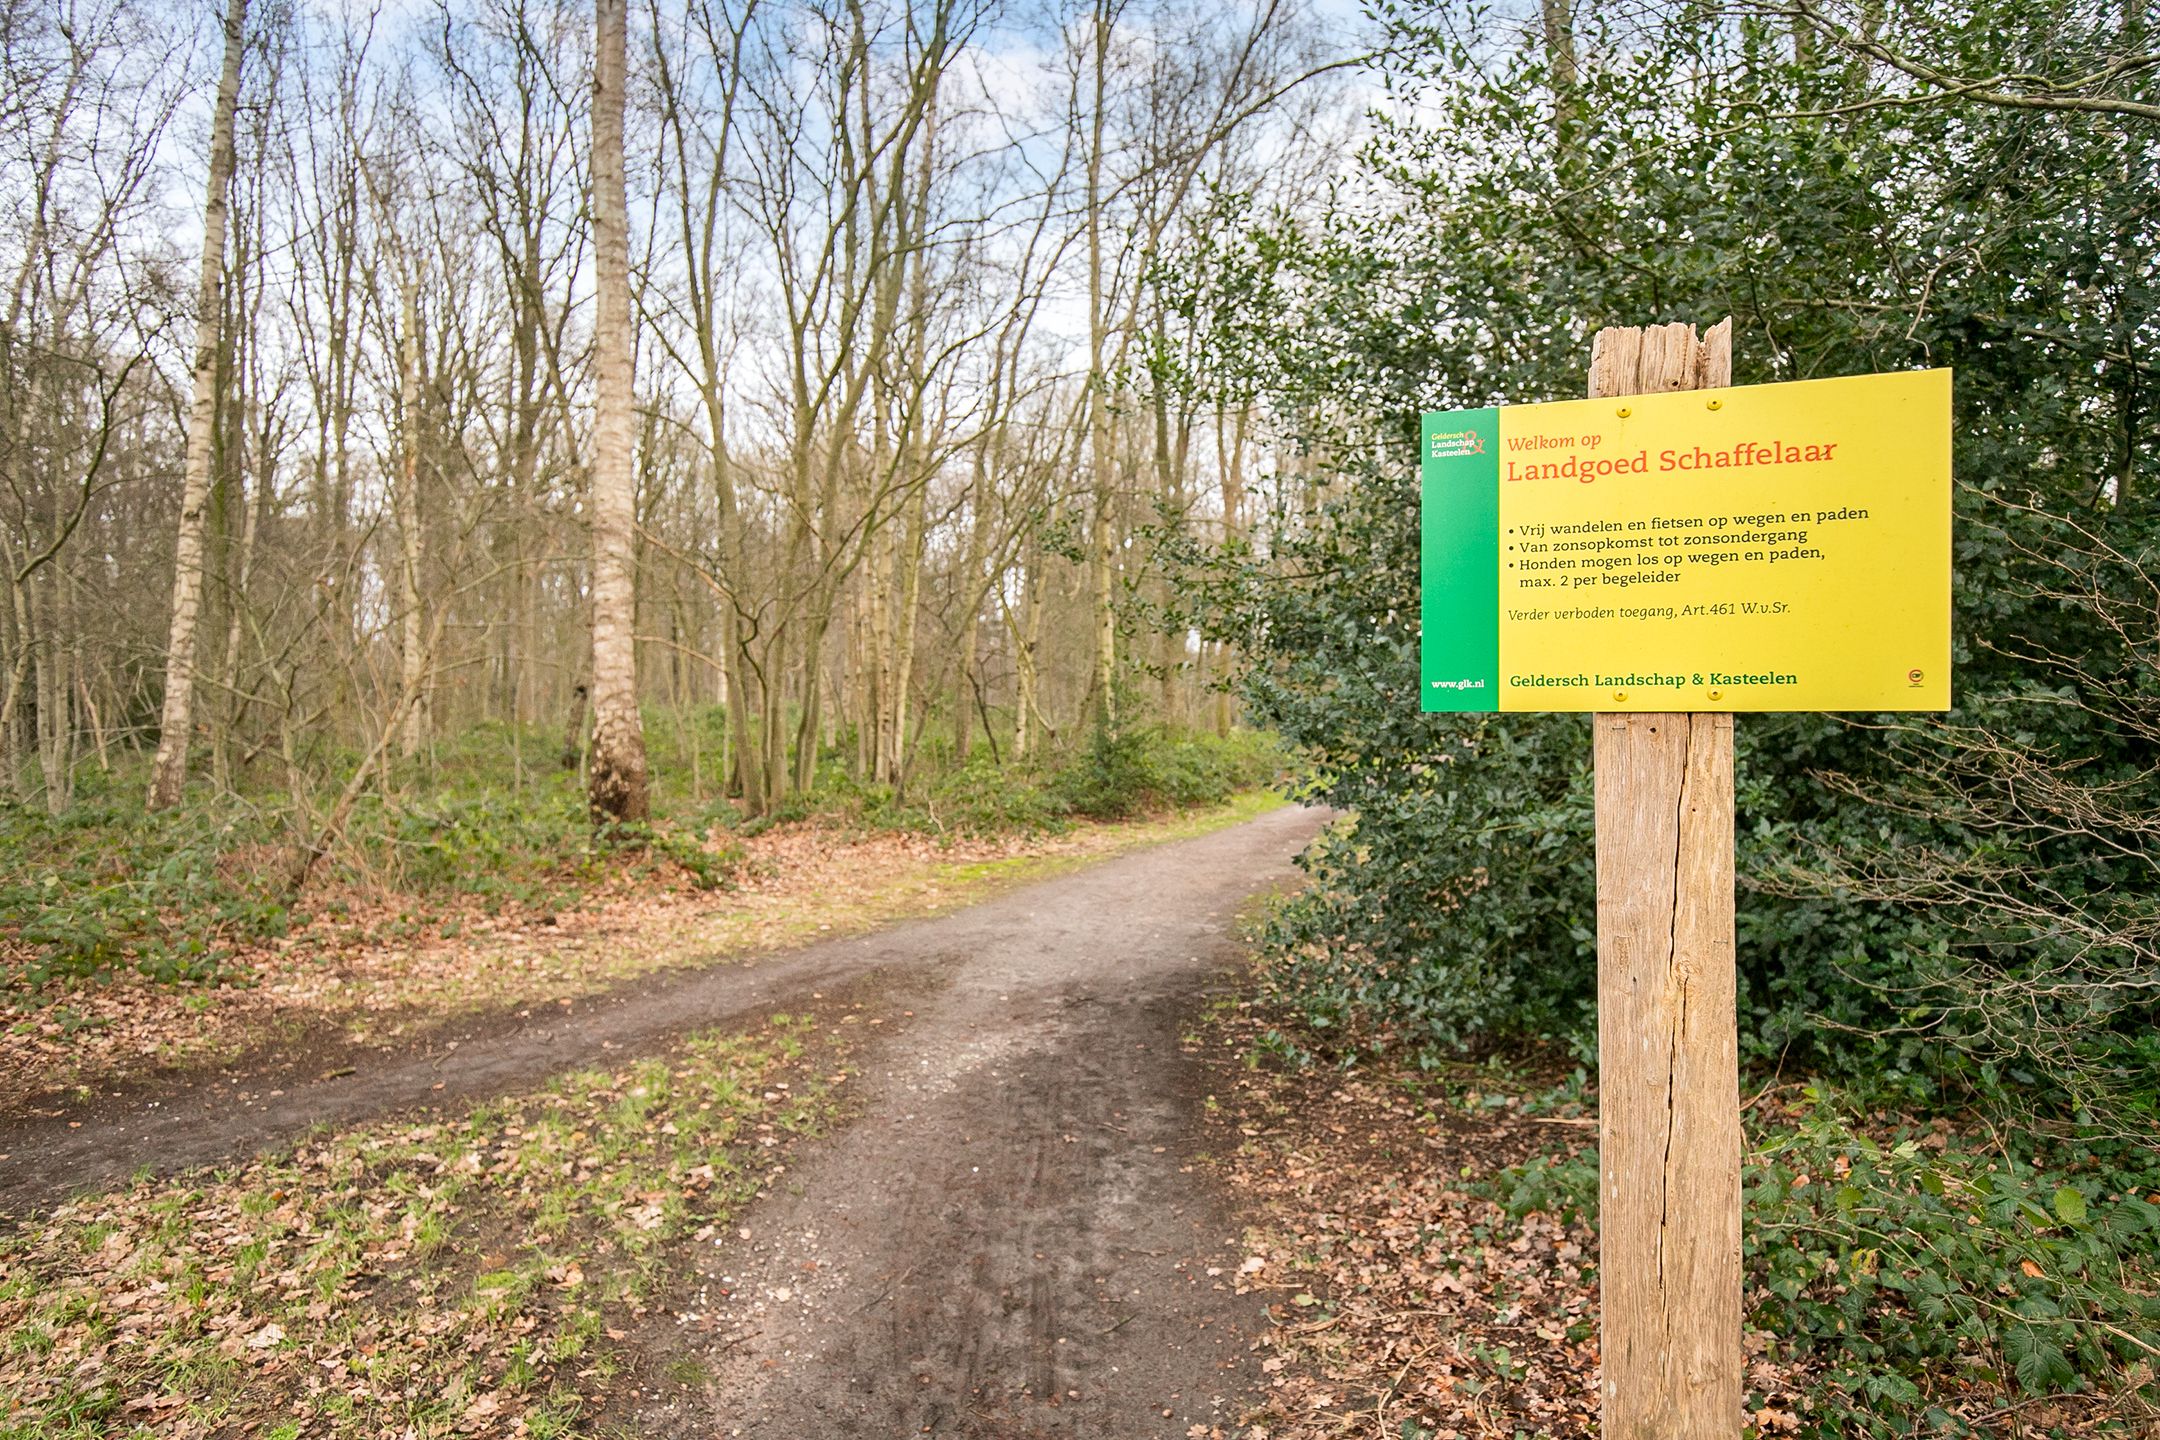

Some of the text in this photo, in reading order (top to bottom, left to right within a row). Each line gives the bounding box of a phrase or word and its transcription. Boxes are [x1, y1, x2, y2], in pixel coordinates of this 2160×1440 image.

[1431, 432, 1464, 440] Geldersch
[1431, 439, 1475, 449] Landschap
[1507, 434, 1602, 451] Welkom op
[1431, 449, 1471, 458] Kasteelen
[1507, 441, 1838, 483] Landgoed Schaffelaar
[1519, 508, 1869, 538] Vrij wandelen en fietsen op wegen en paden
[1519, 529, 1808, 553] Van zonsopkomst tot zonsondergang
[1519, 546, 1825, 571] Honden mogen los op wegen en paden,
[1519, 571, 1681, 589] max. 2 per begeleider
[1508, 601, 1791, 622] Verder verboden toegang, Art.461 W.v.Sr.
[1431, 678, 1485, 690] www.glk.nl
[1510, 671, 1798, 689] Geldersch Landschap & Kasteelen
